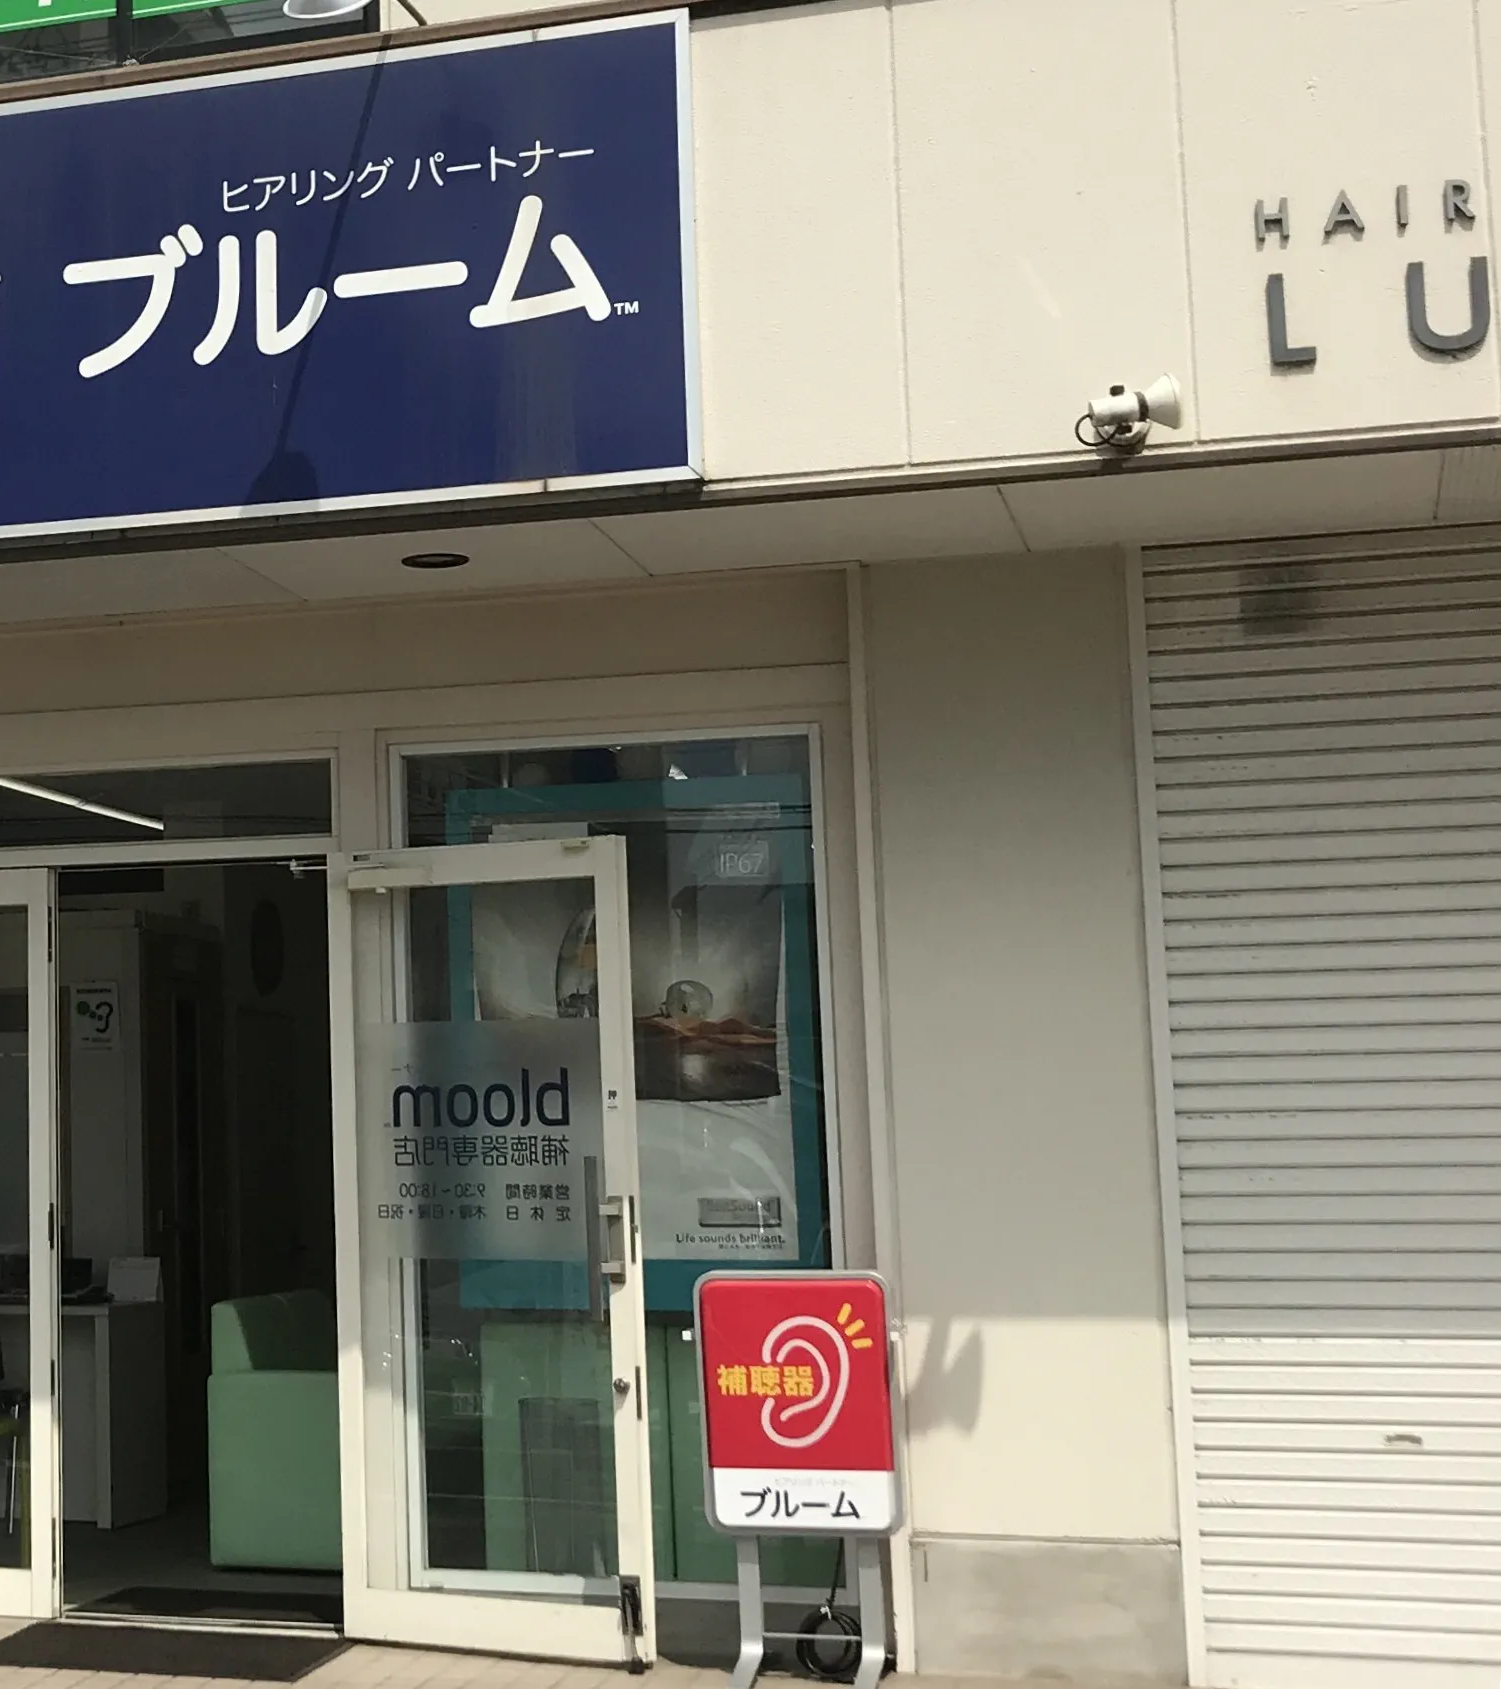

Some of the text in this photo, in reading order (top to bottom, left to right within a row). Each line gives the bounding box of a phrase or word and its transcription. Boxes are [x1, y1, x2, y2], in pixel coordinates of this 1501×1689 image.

[222, 140, 595, 212] ヒアリング パートナー
[1255, 179, 1475, 240] HAIR
[63, 195, 611, 378] ブルーム
[720, 853, 763, 874] IP67
[676, 1233, 696, 1243] Life
[699, 1233, 736, 1243] sounds
[717, 1365, 814, 1396] 補聴器
[741, 1486, 860, 1519] ブルーム
